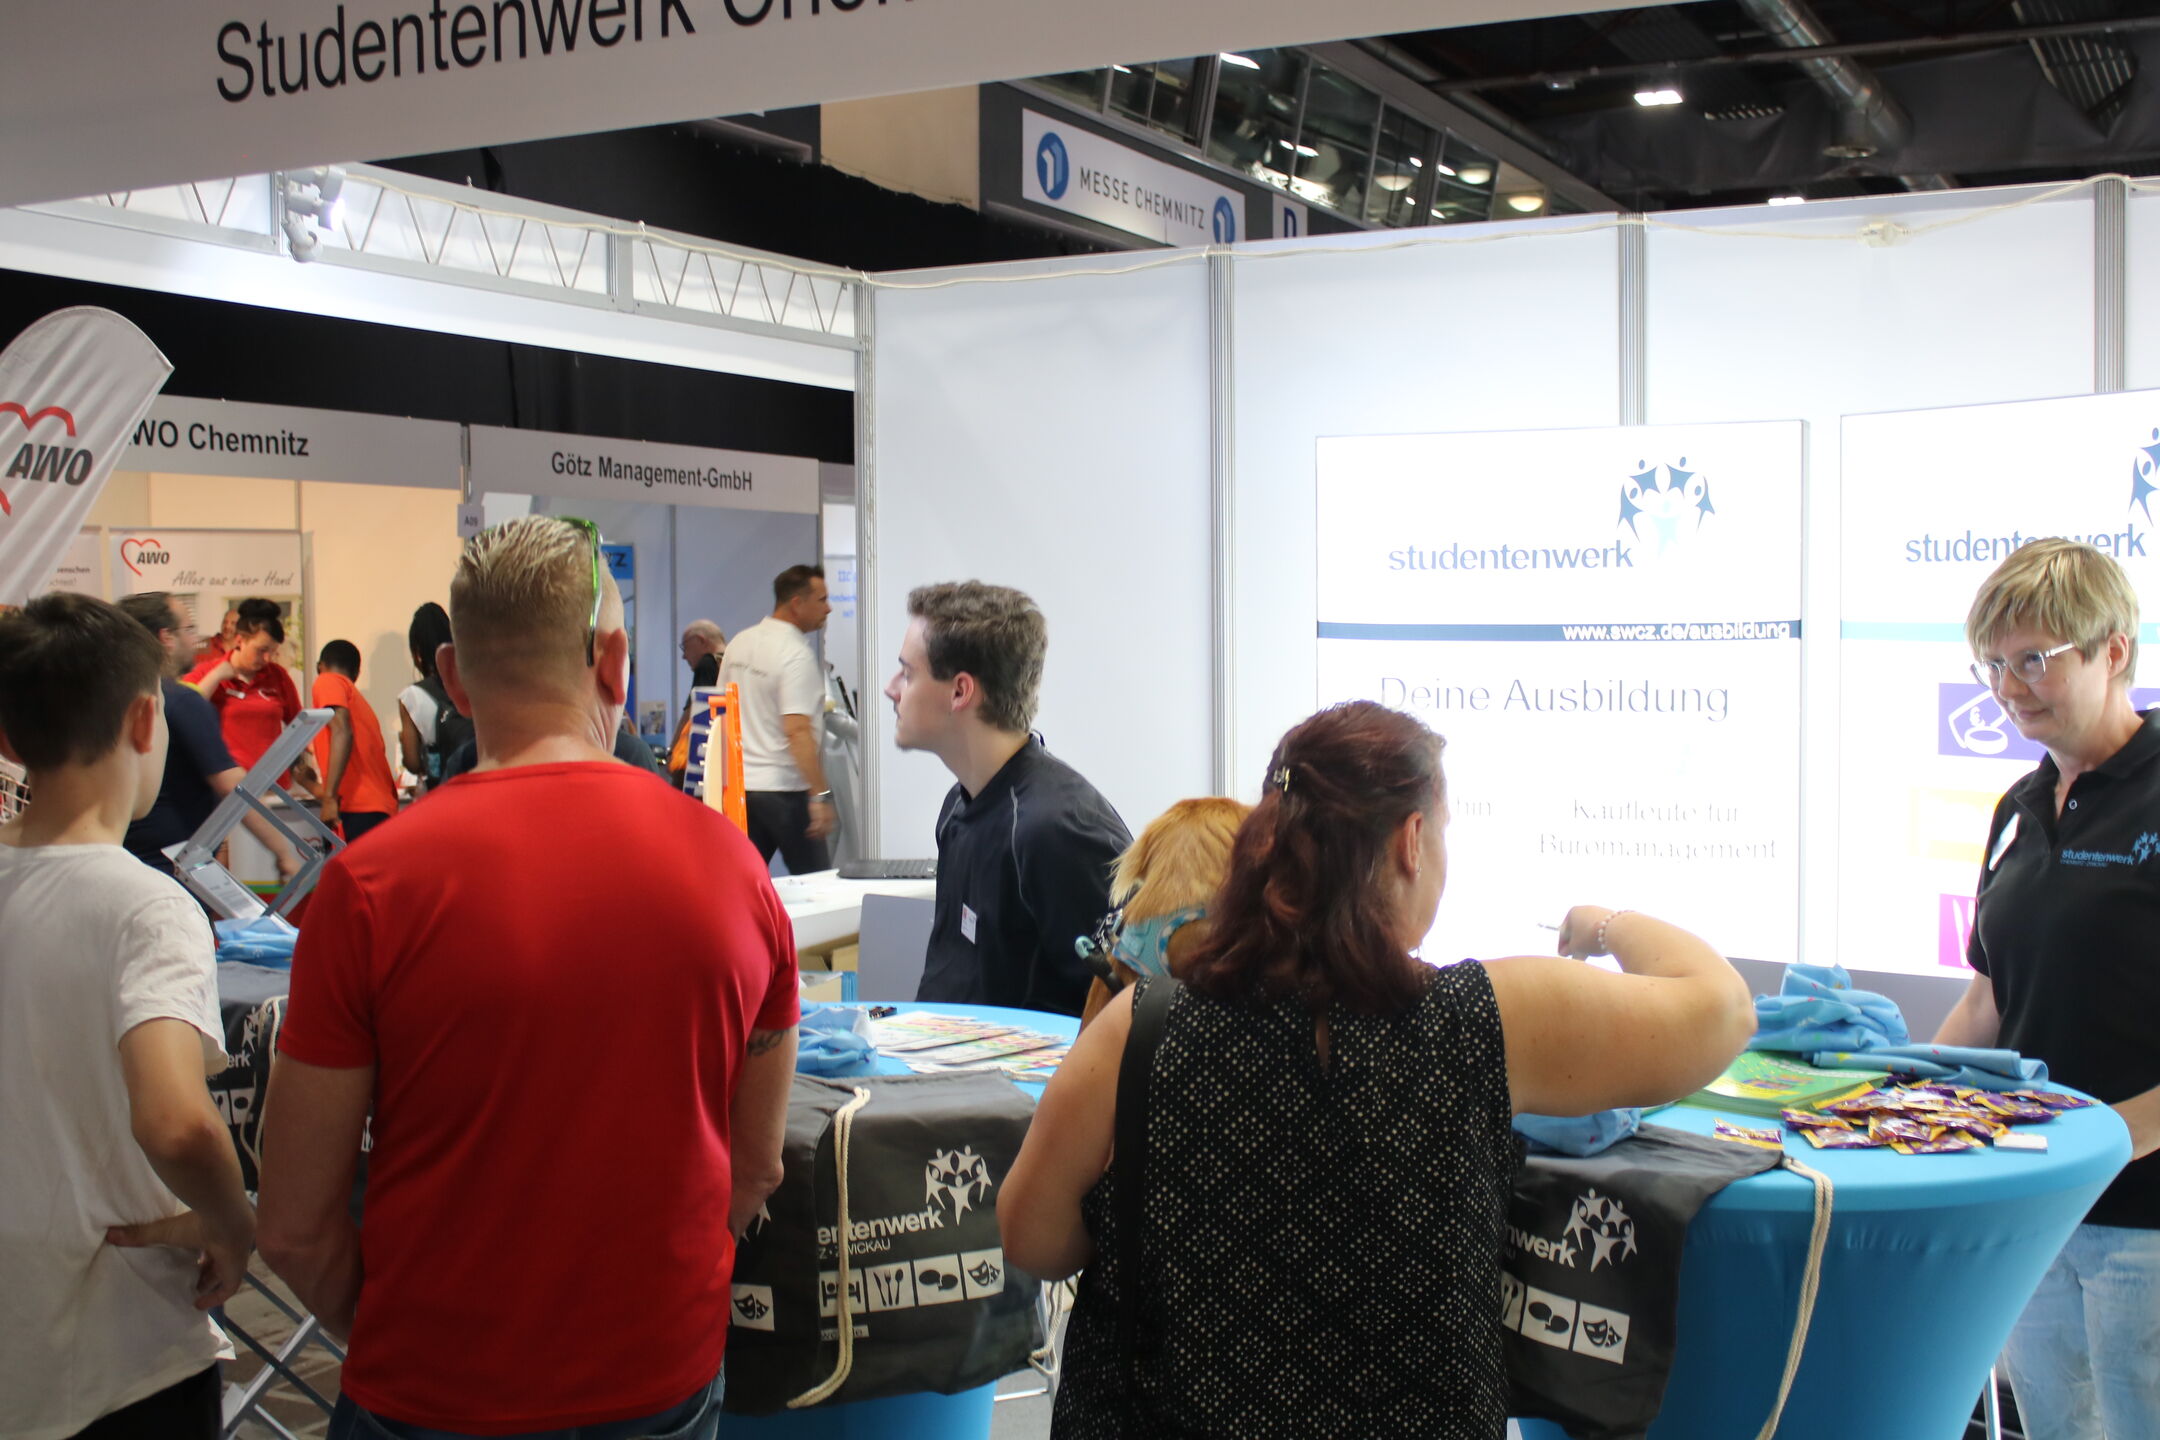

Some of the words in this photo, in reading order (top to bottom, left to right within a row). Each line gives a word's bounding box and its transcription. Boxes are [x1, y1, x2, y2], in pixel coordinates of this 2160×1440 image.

[1079, 166, 1129, 205] MESSE
[1135, 186, 1205, 230] CHEMNITZ
[129, 418, 179, 448] WO
[188, 423, 309, 457] Chemnitz
[5, 443, 93, 486] AWO
[551, 451, 592, 477] Götz
[599, 456, 752, 491] Management-GmbH
[137, 551, 170, 565] AWO
[1388, 540, 1634, 570] studentenwerk
[1905, 523, 2147, 562] studenterk
[1562, 621, 1790, 641] www.swcz.de/ausbildung
[1381, 677, 1489, 712] Deine
[1504, 679, 1728, 722] Ausbildung
[2061, 848, 2134, 865] studentenwerk
